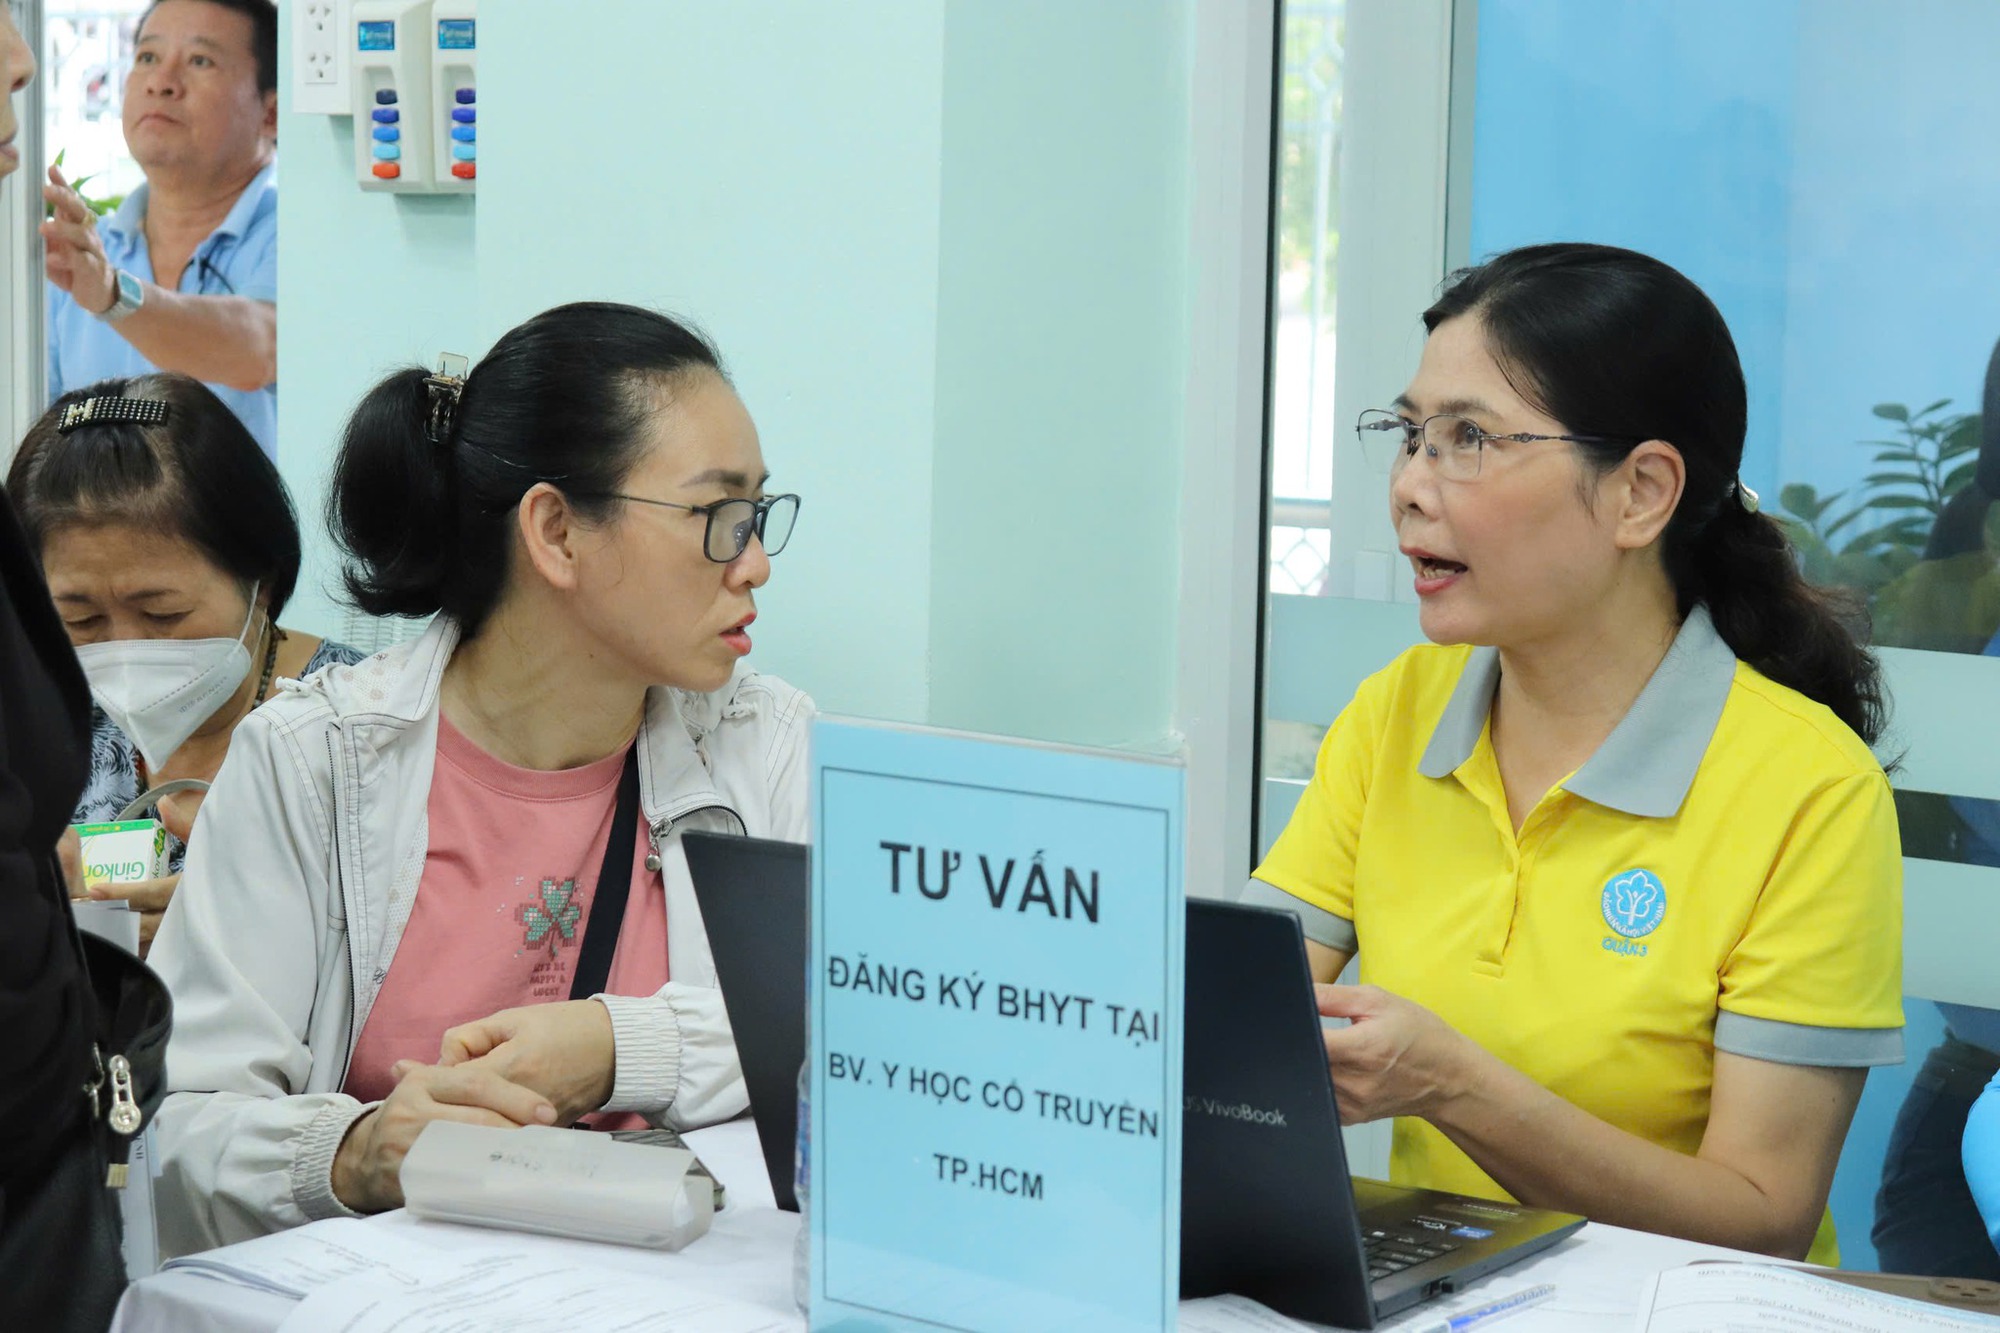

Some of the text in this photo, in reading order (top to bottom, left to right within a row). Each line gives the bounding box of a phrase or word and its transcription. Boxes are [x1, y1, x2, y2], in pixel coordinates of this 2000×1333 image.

[879, 839, 1099, 924] TƯ VẤN
[828, 952, 1159, 1047] ĐĂNG KÝ BHYT TẠI
[829, 1052, 873, 1086] BV.
[882, 1061, 900, 1089] Y
[909, 1066, 971, 1105] HỌC
[1203, 1097, 1288, 1127] VivoBook
[933, 1152, 1044, 1201] TP.HCM
